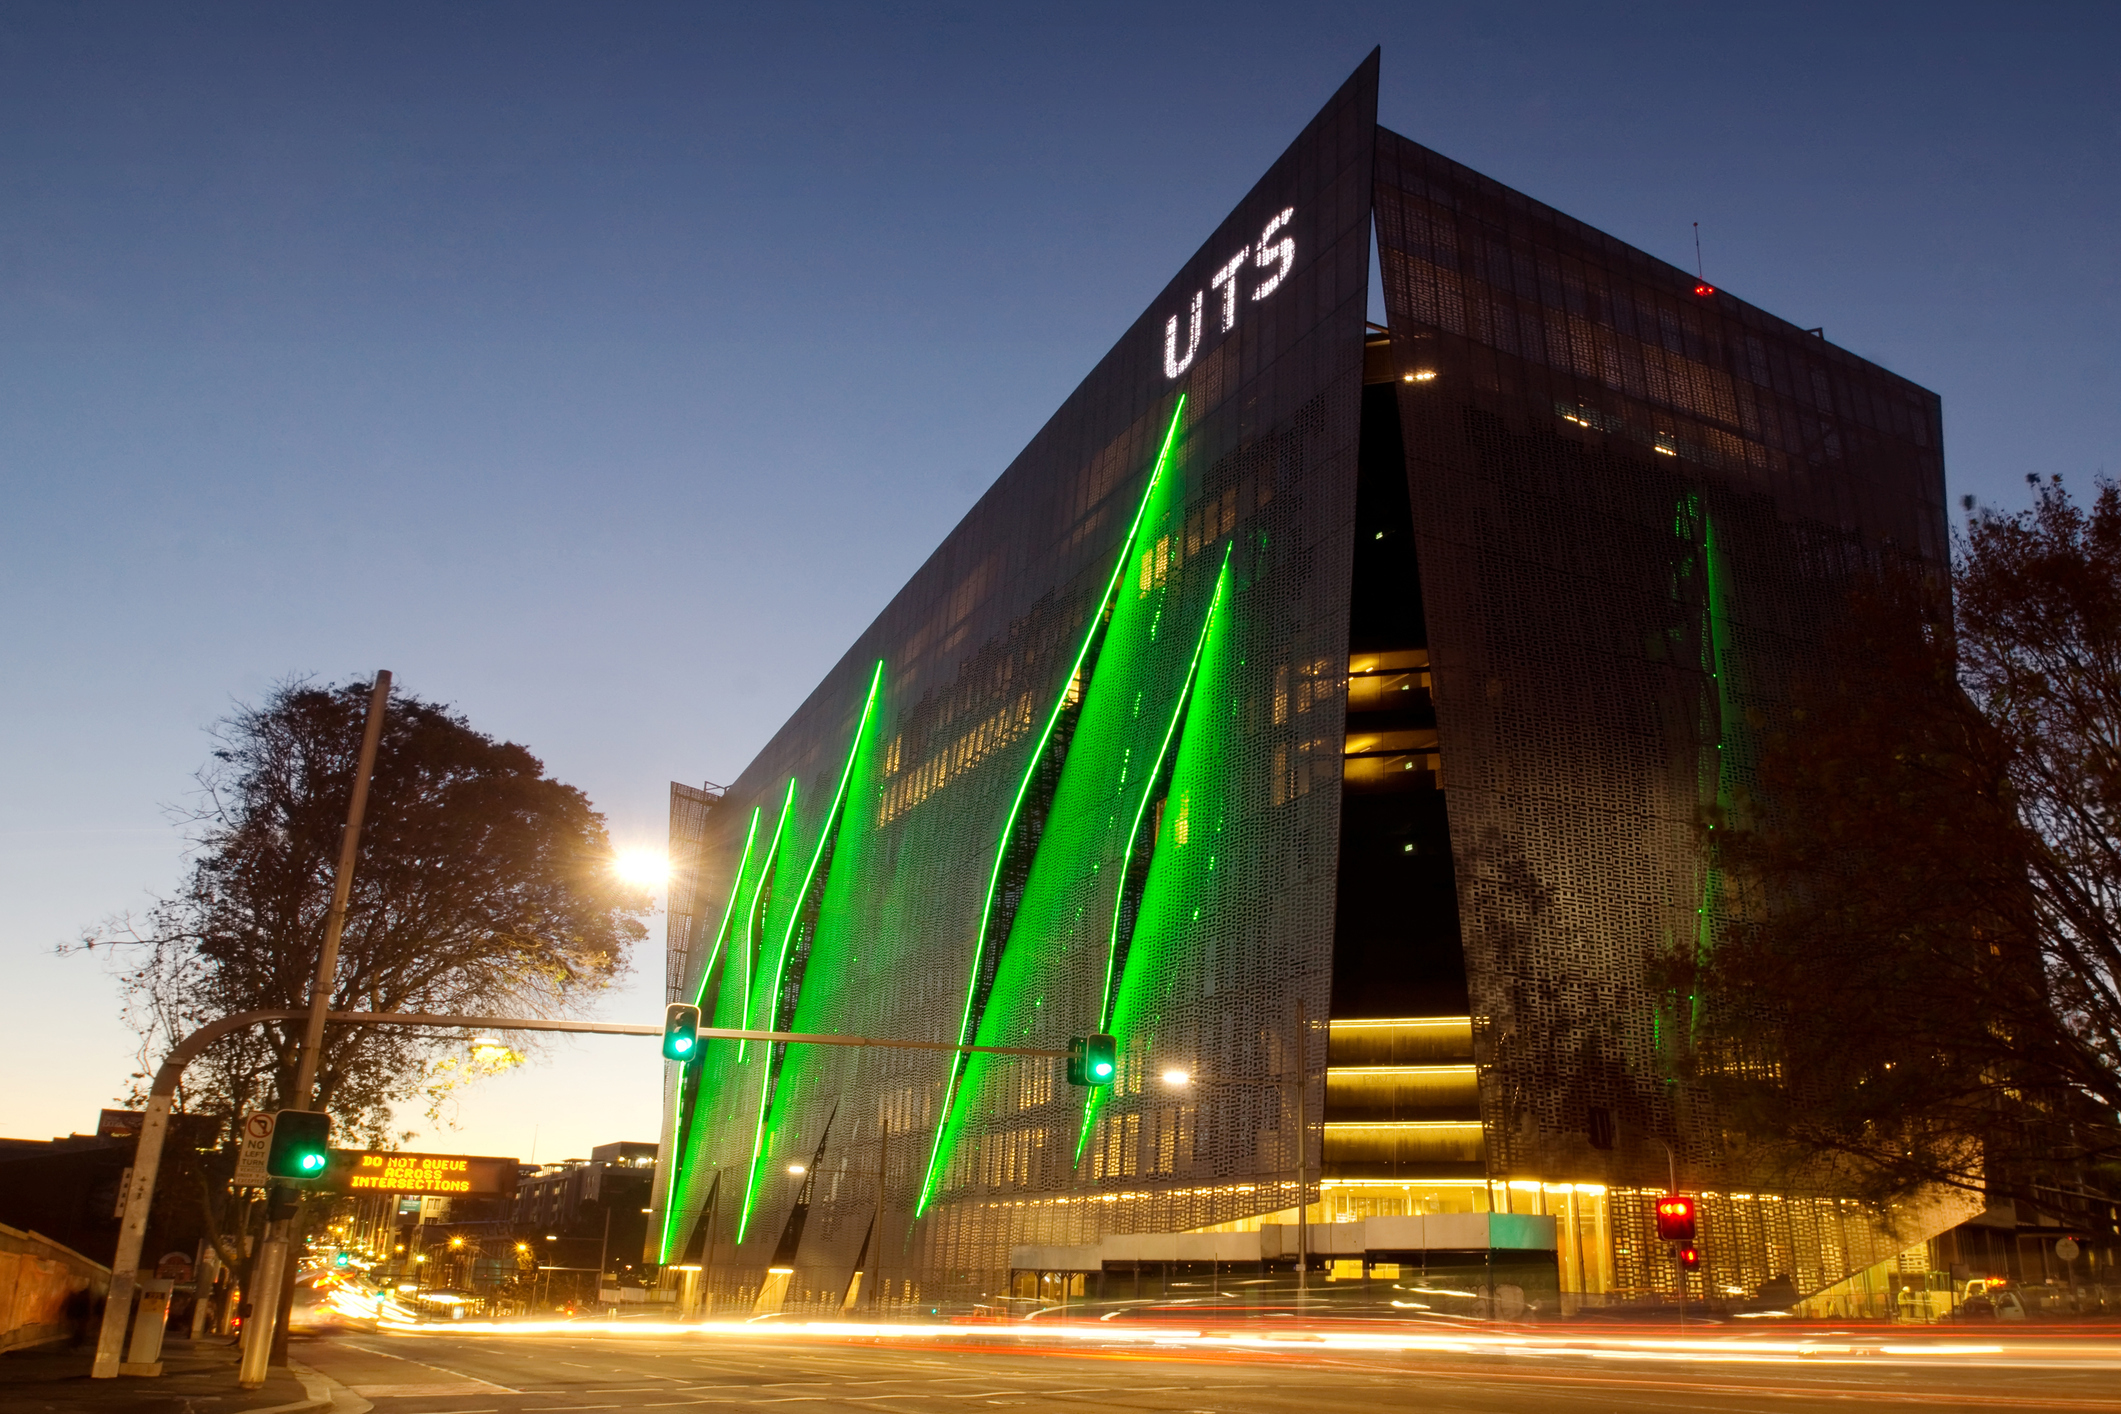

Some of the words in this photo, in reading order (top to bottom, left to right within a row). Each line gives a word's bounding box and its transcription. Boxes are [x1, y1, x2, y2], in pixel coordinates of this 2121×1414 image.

[1163, 206, 1296, 379] UTS
[247, 1140, 265, 1149] NO
[362, 1155, 383, 1167] DO
[387, 1157, 417, 1169] NOT
[422, 1159, 468, 1171] QUEUE
[384, 1167, 443, 1180] ACROSS
[351, 1176, 471, 1191] INTERSECTIONS
